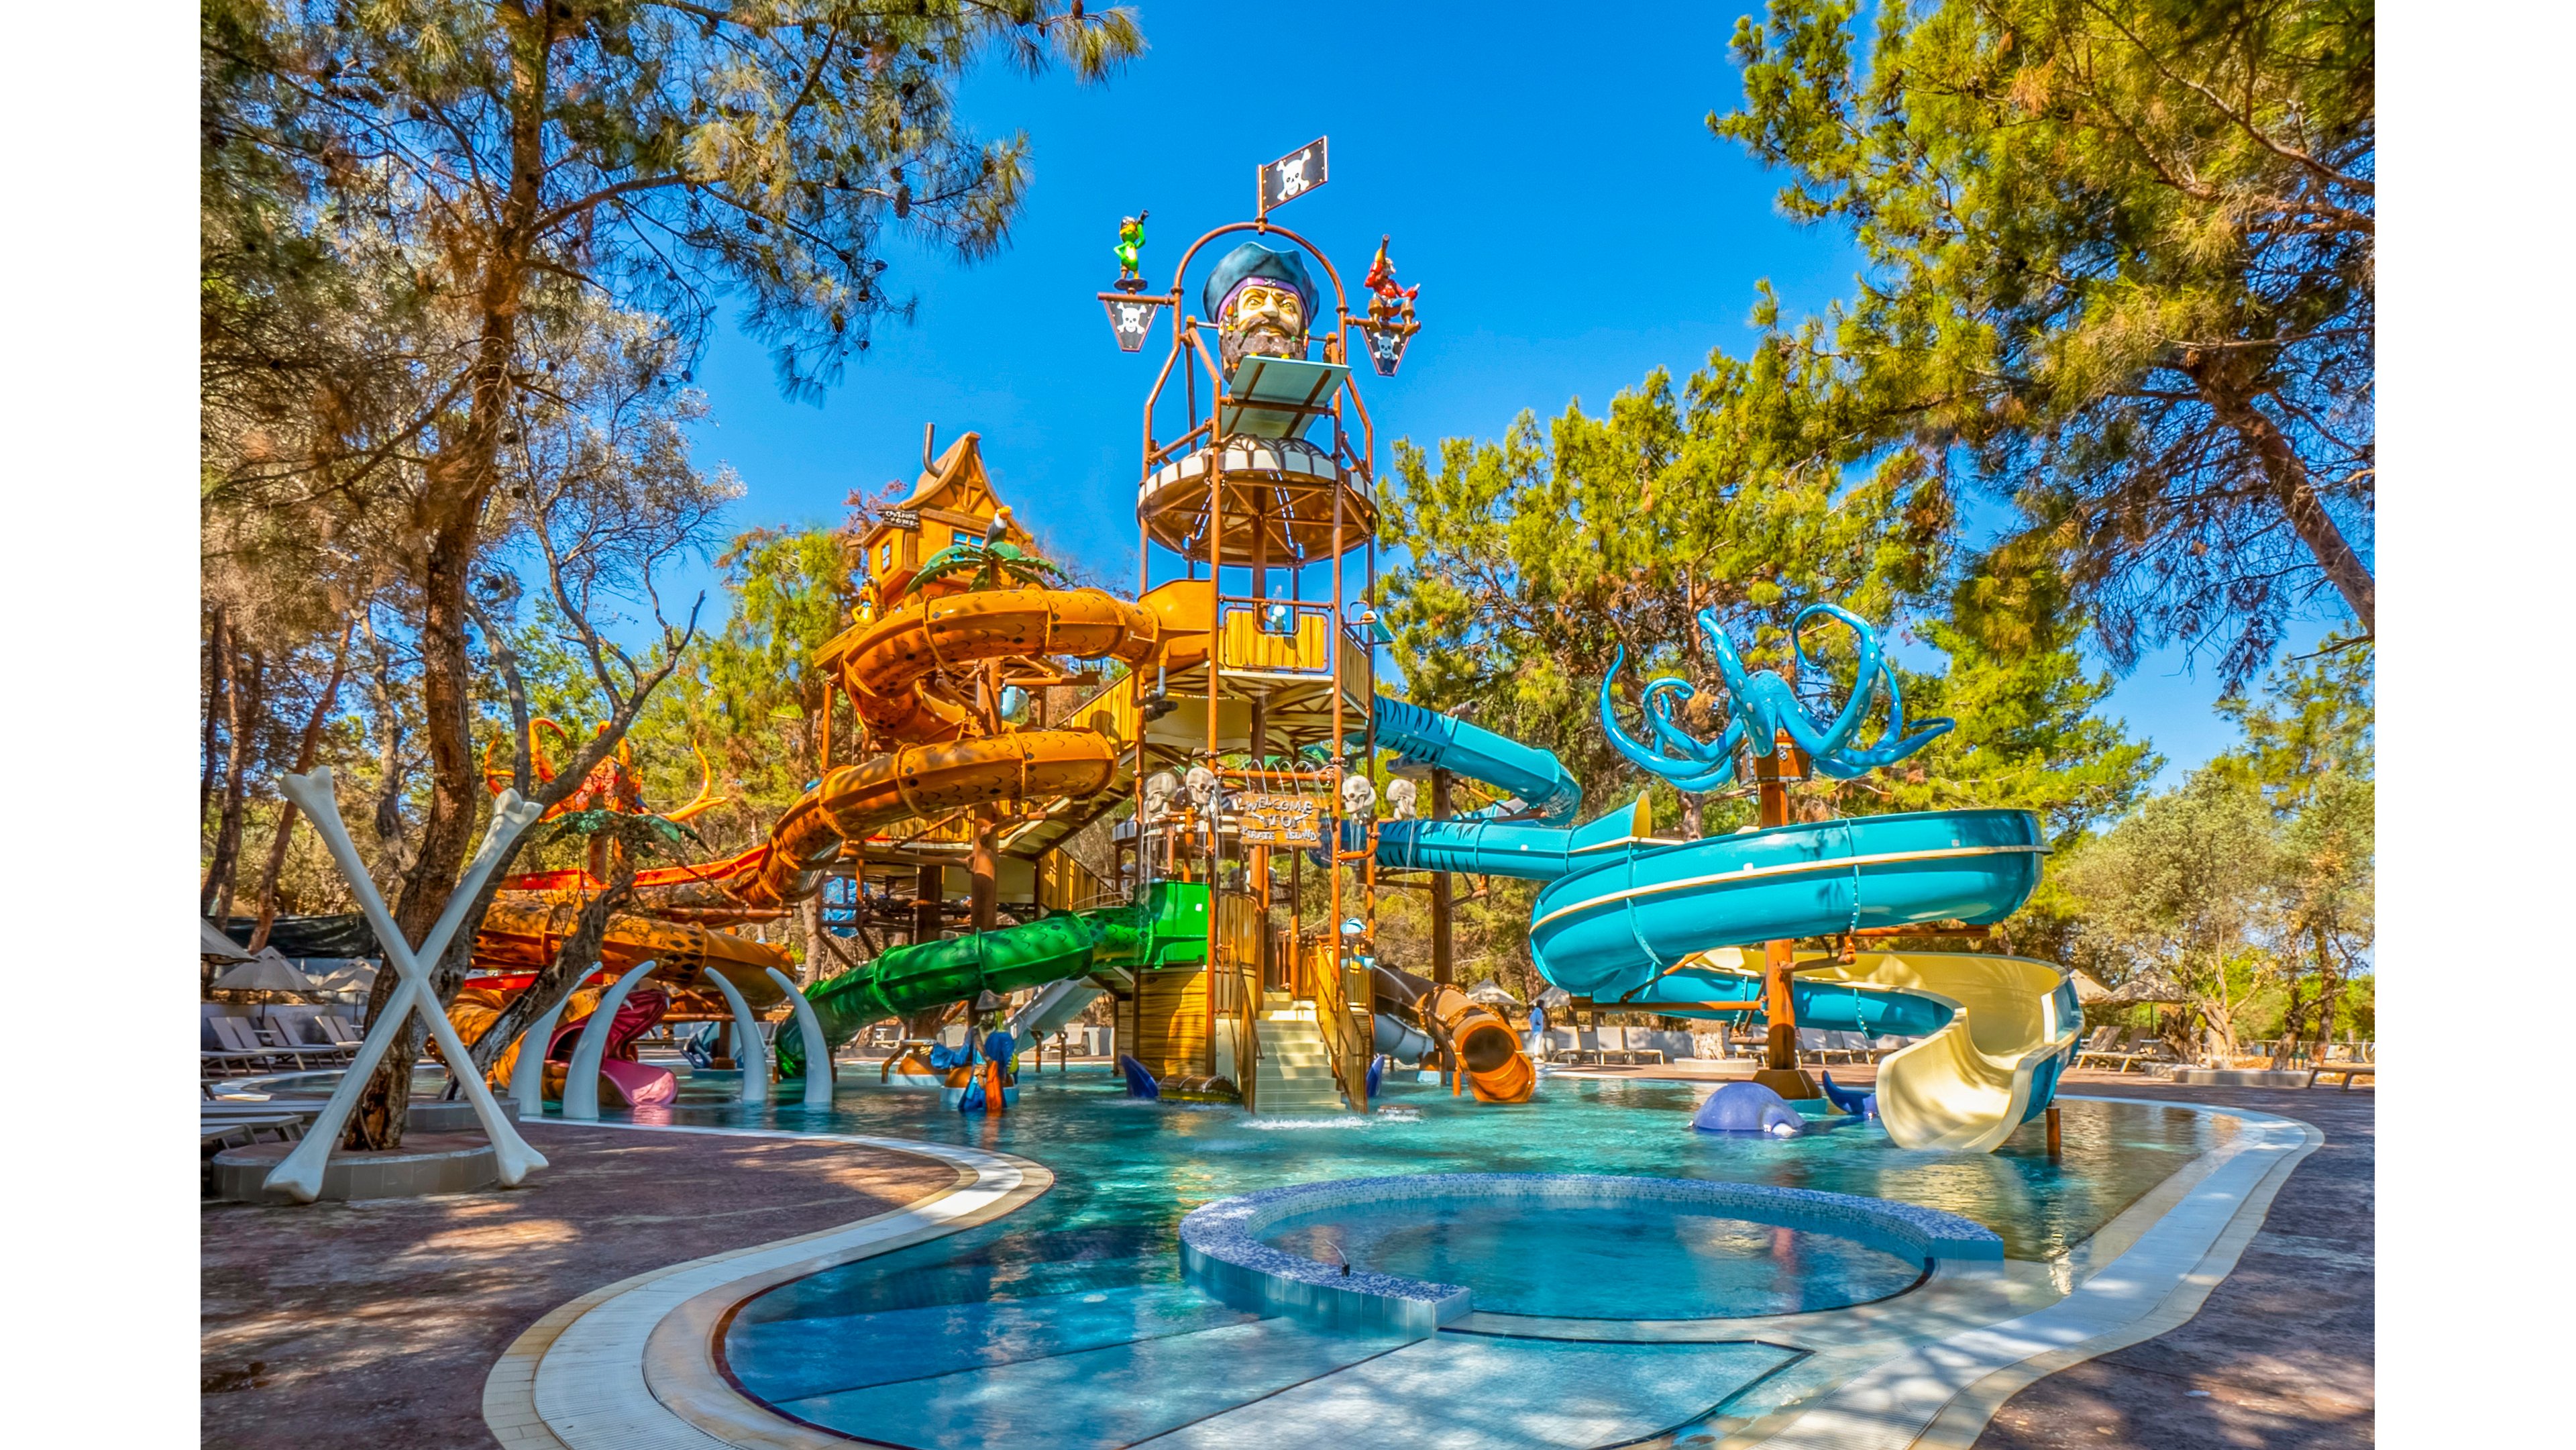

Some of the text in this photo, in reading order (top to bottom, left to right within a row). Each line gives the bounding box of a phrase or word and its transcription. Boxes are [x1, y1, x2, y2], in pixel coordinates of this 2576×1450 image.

[1246, 796, 1312, 814] WELCOME
[1269, 815, 1291, 827] TO
[1242, 826, 1317, 841] PIRATE ISLAND
